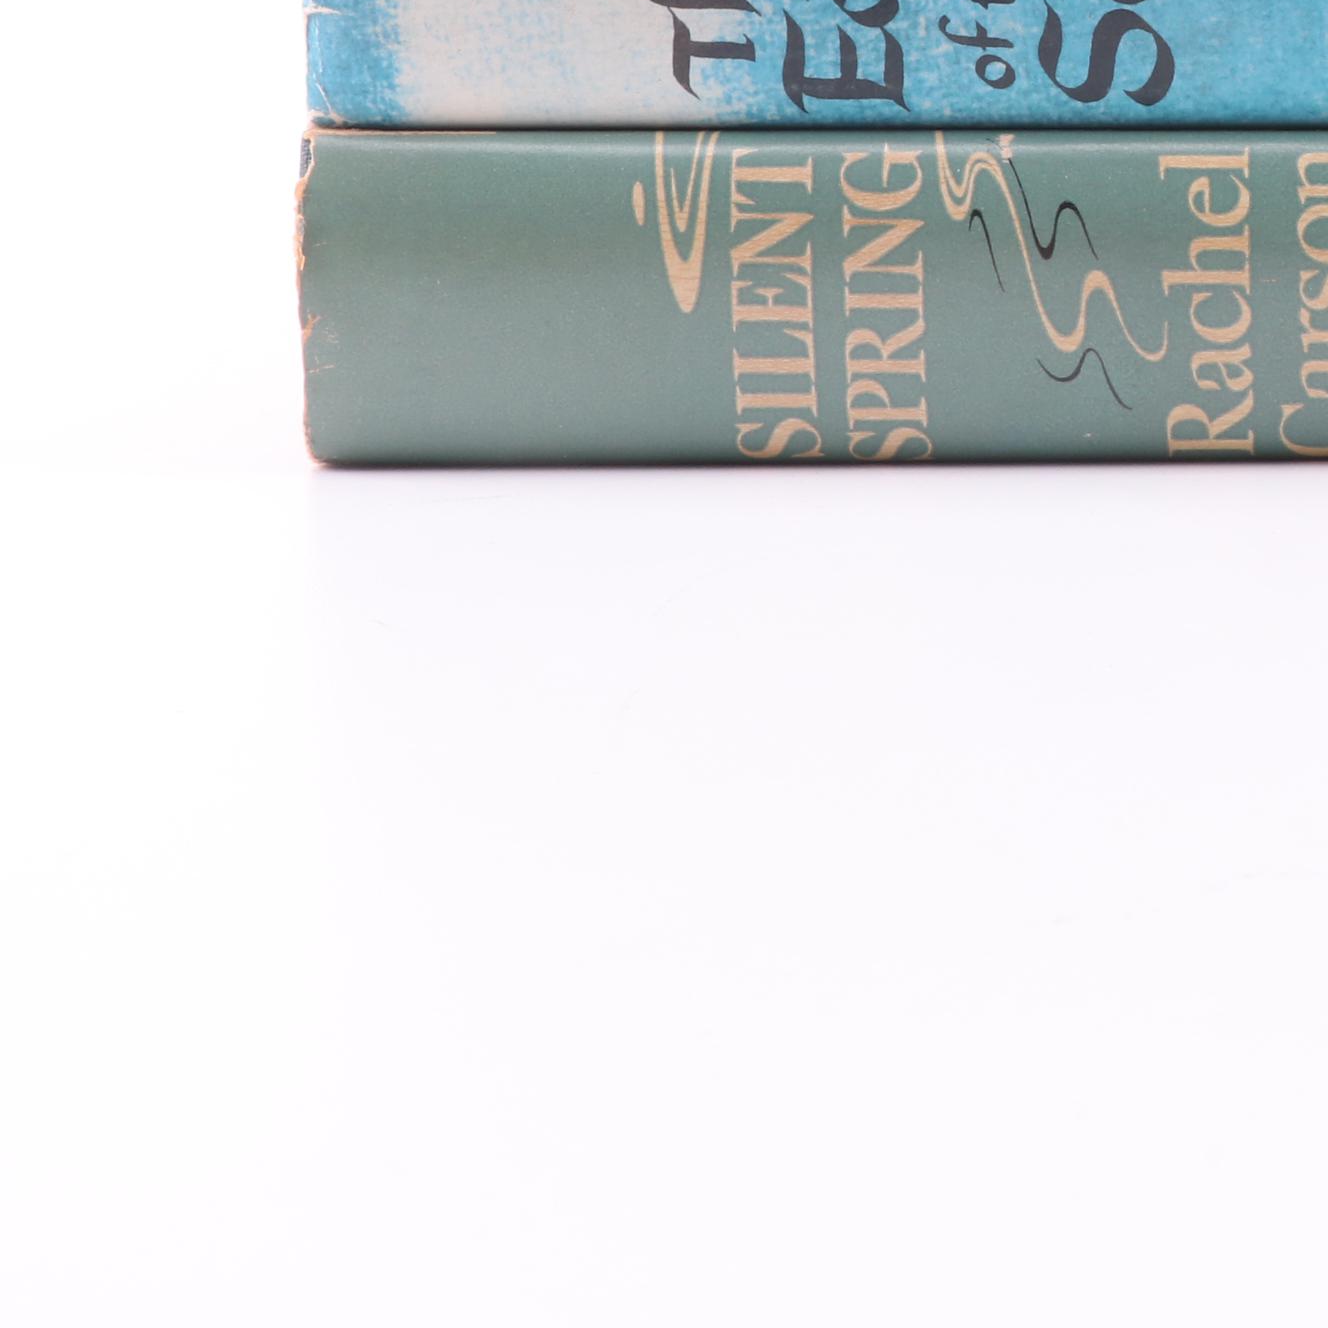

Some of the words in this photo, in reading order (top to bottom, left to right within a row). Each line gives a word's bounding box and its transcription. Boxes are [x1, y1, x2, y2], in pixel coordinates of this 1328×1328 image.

[938, 14, 1016, 89] of
[730, 148, 825, 459] SILENT
[840, 142, 936, 462] SPRING
[1158, 145, 1255, 458] Rachel
